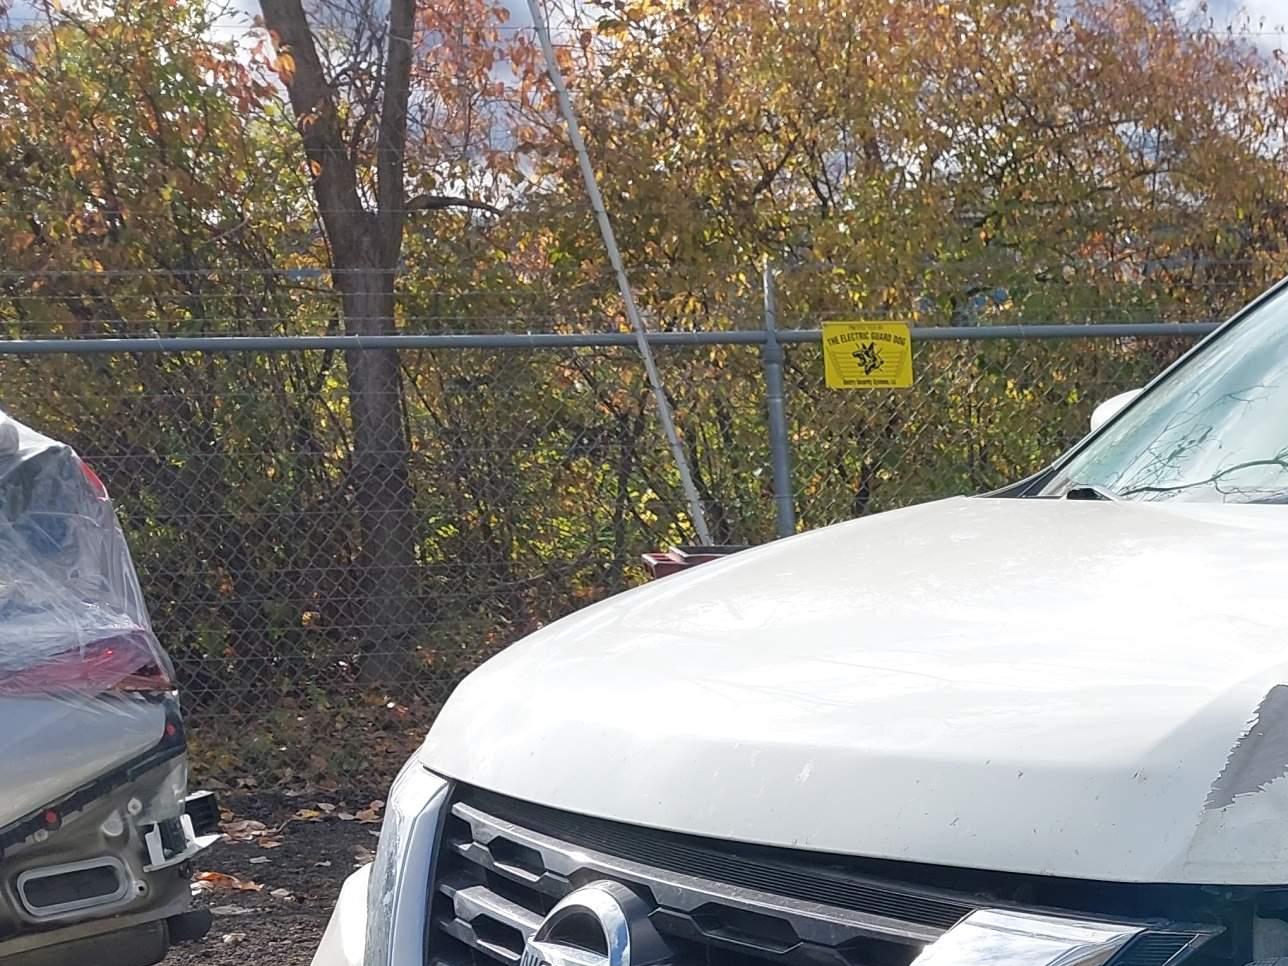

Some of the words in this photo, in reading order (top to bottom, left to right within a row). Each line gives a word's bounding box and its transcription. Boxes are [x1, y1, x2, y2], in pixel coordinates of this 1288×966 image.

[827, 337, 840, 346] THE
[840, 331, 869, 342] ELECTRIC
[870, 331, 892, 342] GUARD
[893, 335, 906, 346] DOG
